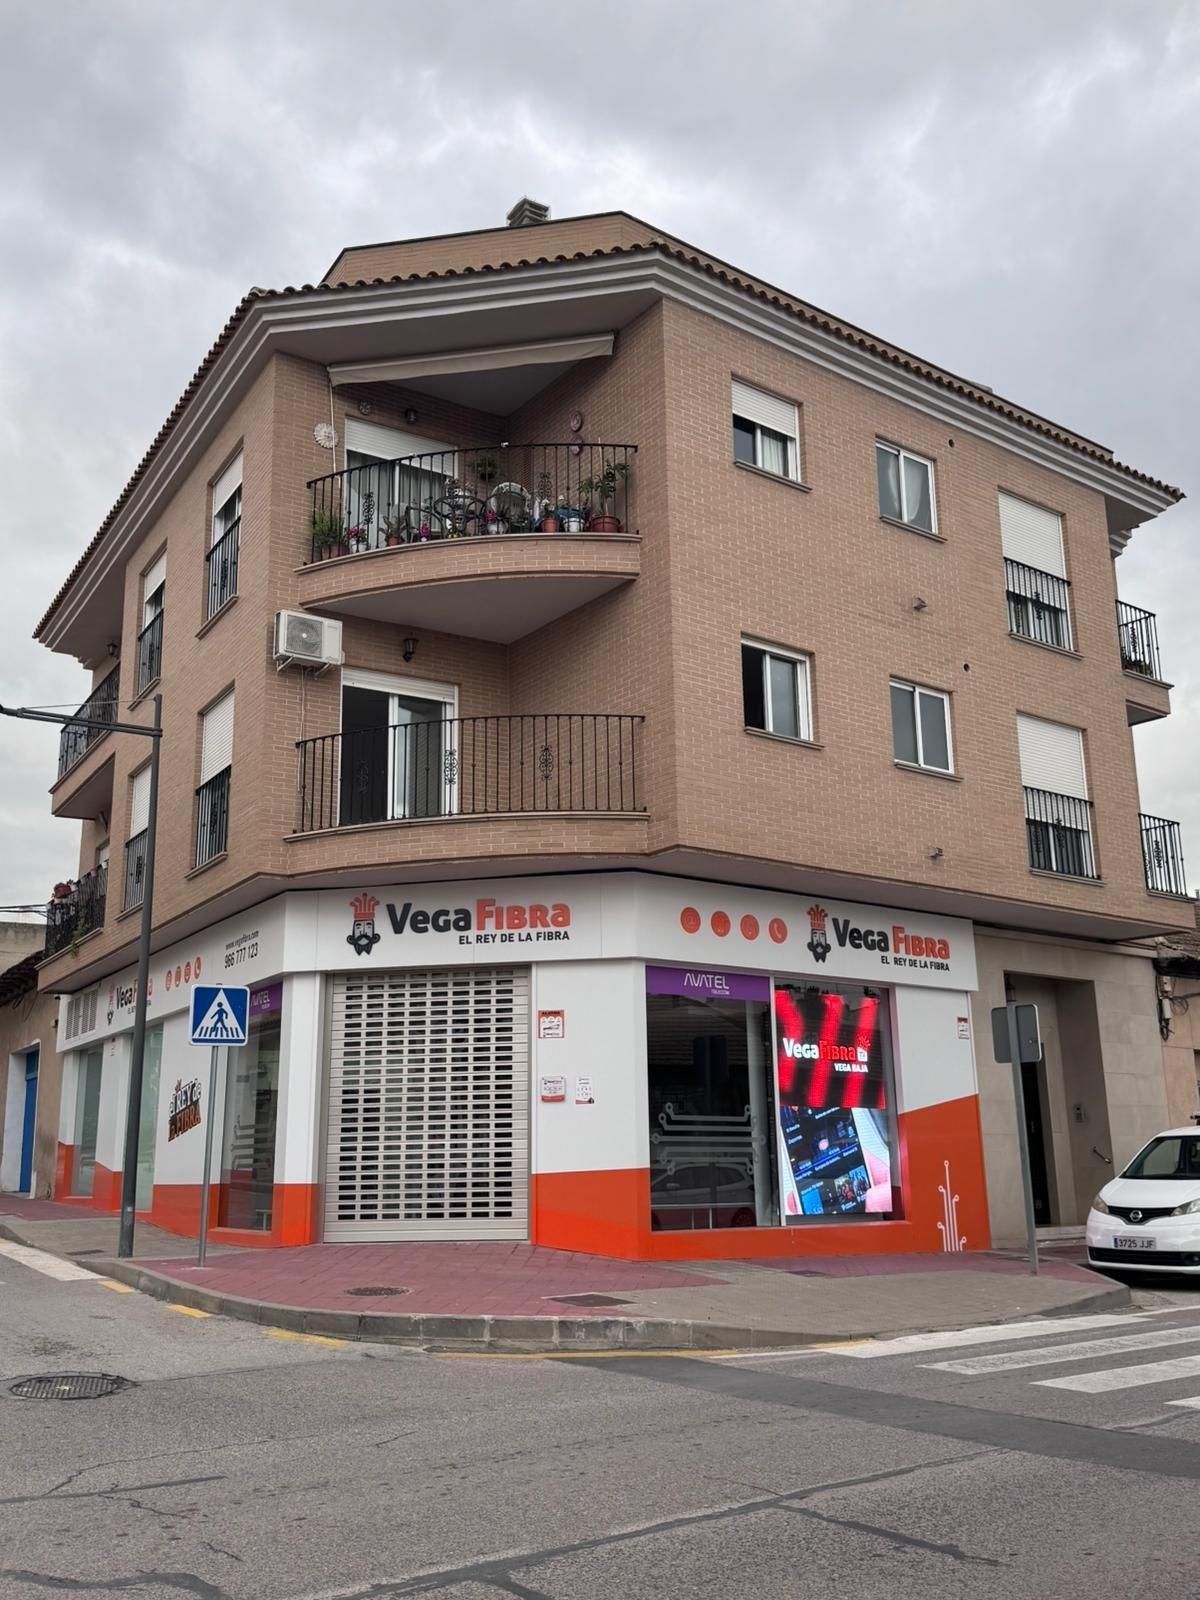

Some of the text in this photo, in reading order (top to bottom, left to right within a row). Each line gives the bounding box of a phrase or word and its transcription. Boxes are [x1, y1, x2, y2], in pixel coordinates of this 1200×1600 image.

[459, 931, 570, 945] EL REY DE LA FIBRA
[236, 946, 246, 965] 777
[247, 942, 258, 959] 123
[881, 955, 950, 972] EL REY DE LA FIBRA
[684, 973, 729, 989] AVATEL
[834, 1062, 868, 1072] VEGA BAJA
[1118, 1239, 1154, 1249] 3725 JJF
